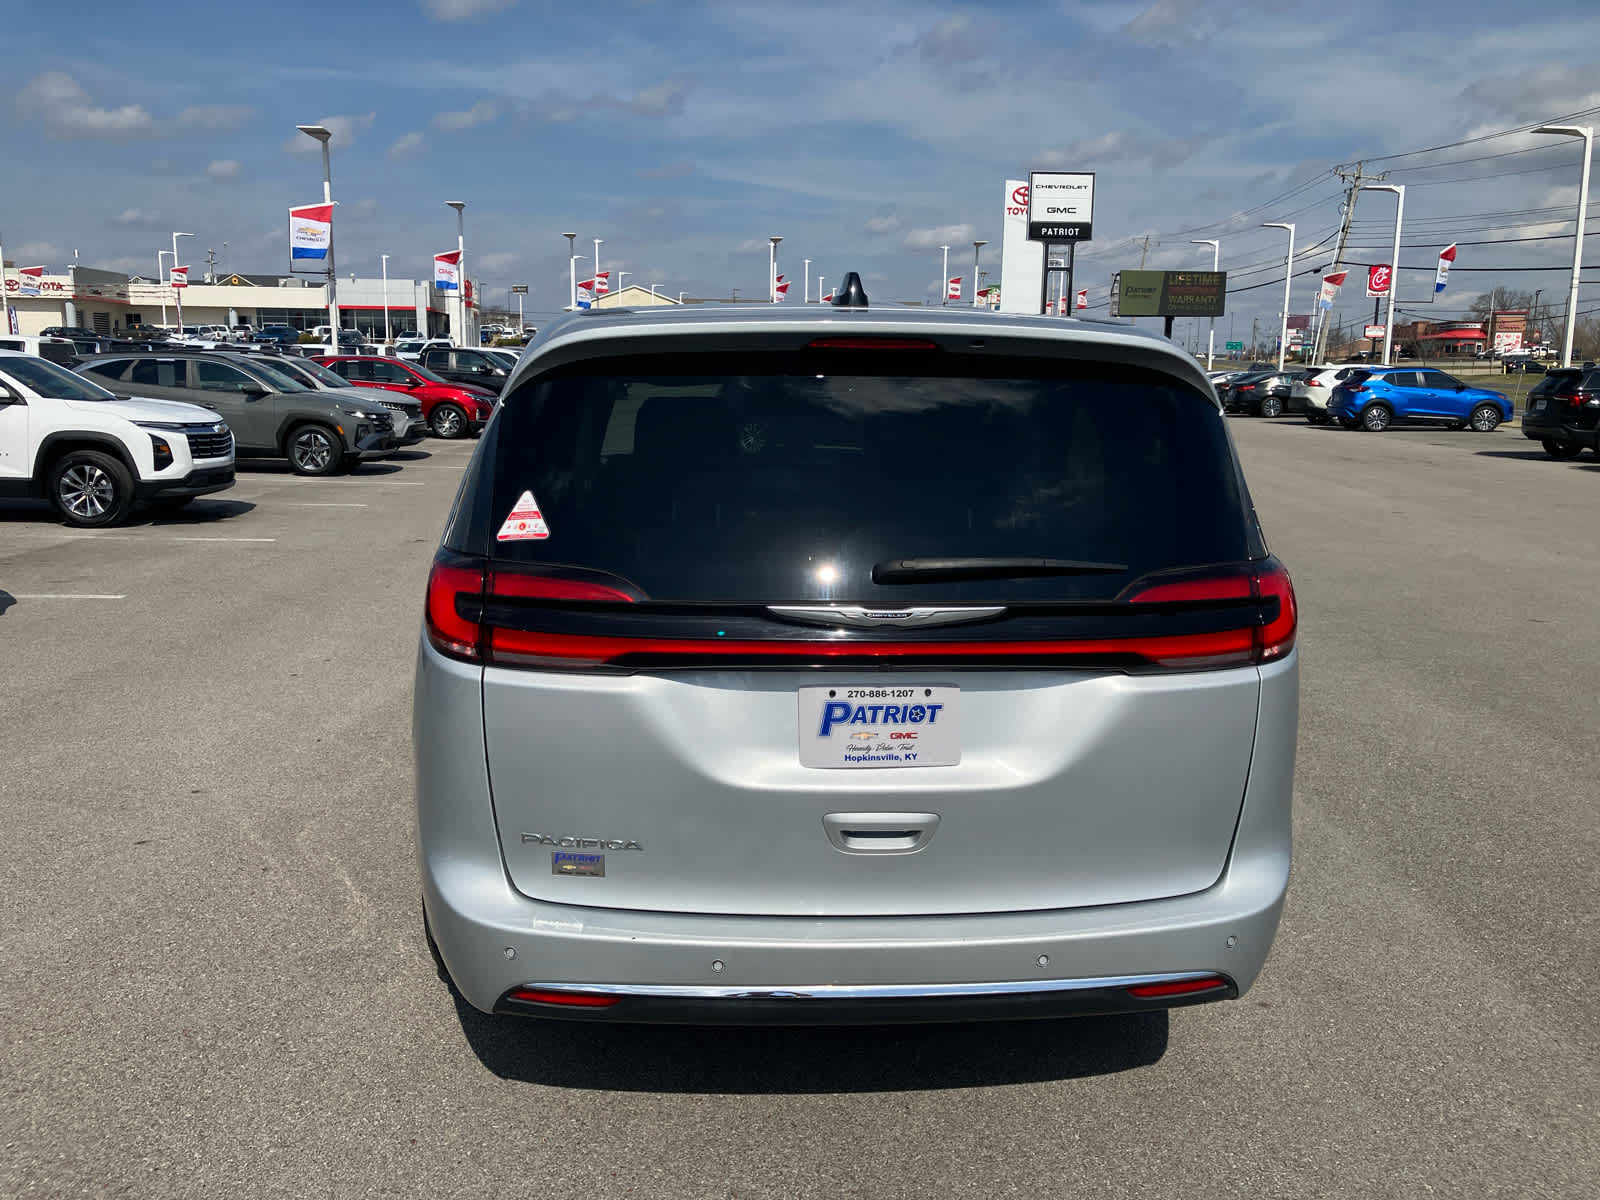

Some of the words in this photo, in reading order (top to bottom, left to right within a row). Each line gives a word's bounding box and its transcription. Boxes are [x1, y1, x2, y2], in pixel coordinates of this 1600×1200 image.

[1041, 228, 1080, 236] PATRIOT
[1168, 273, 1221, 286] LIFETIME
[847, 689, 914, 698] 270-886-1207
[818, 701, 943, 737] PATRIOT
[889, 732, 919, 740] GMC
[844, 754, 902, 763] Hopkinsville,
[520, 832, 643, 852] PACIFICA
